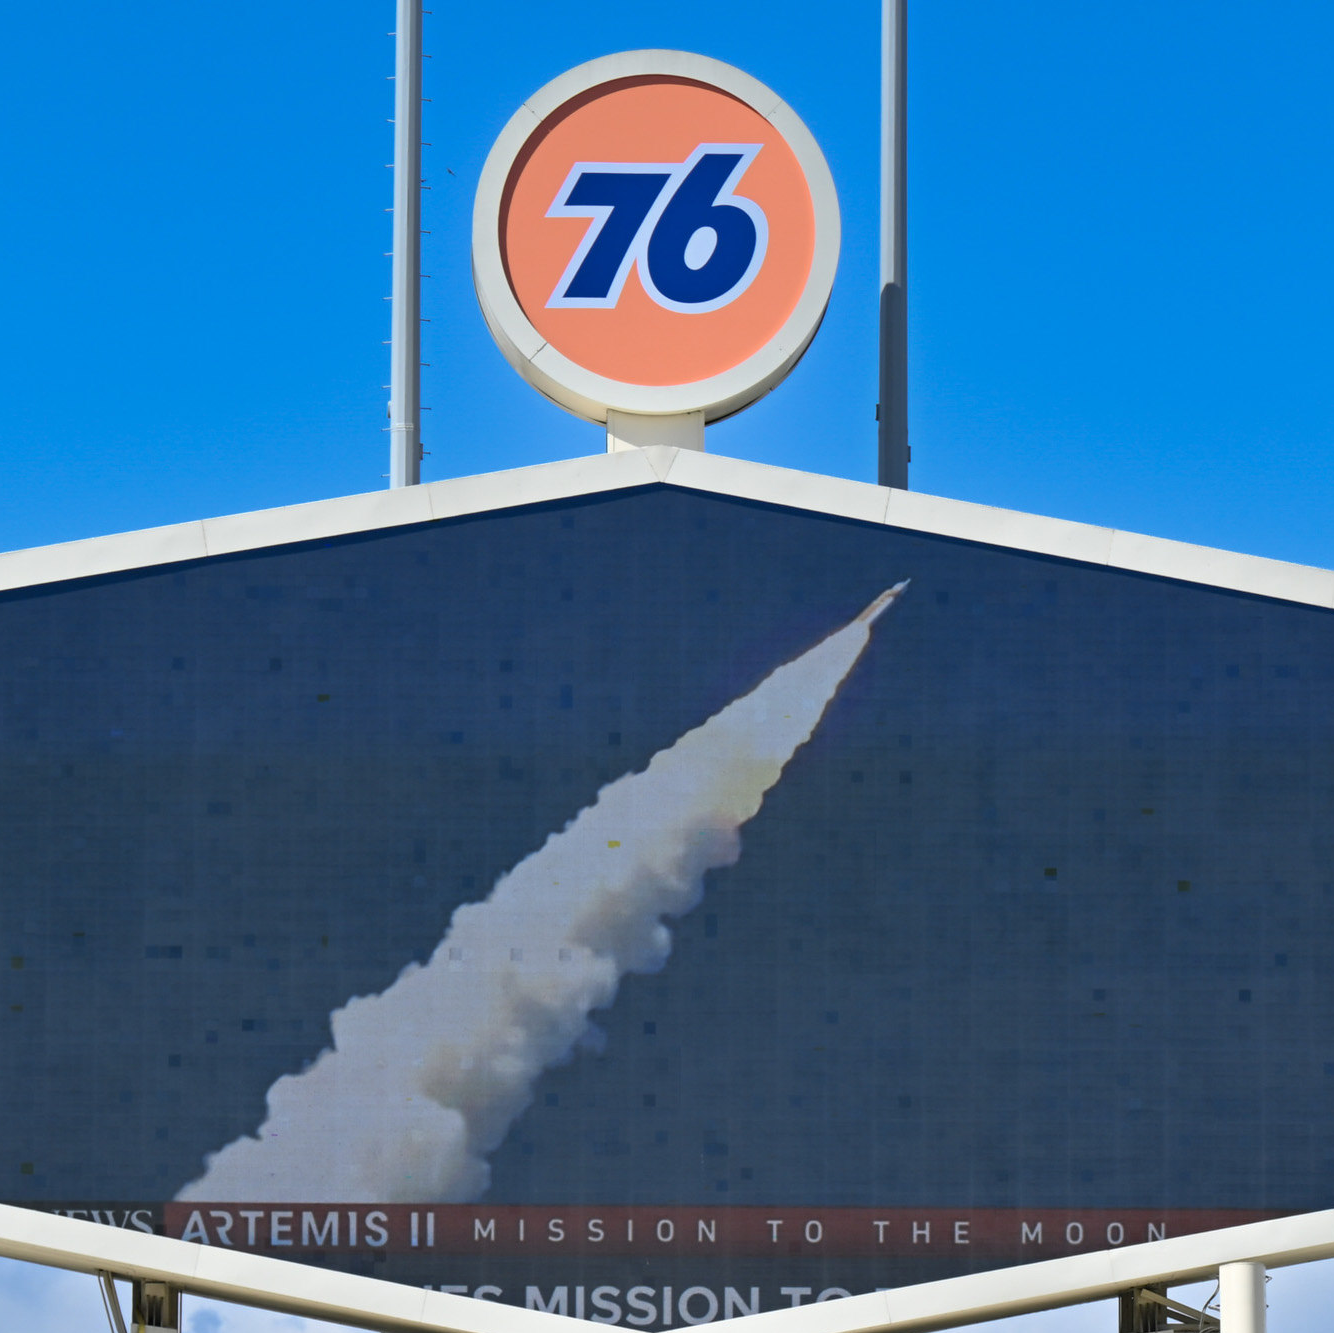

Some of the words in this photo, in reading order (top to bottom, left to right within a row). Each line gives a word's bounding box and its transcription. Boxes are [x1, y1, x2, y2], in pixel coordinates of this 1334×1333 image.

[545, 143, 768, 314] 76
[182, 1209, 389, 1247] ARTEMIS
[410, 1211, 435, 1248] II
[473, 1217, 717, 1243] MISSION
[767, 1220, 823, 1243] TO
[873, 1221, 970, 1245] THE
[1022, 1222, 1167, 1246] MOON
[526, 1286, 759, 1325] MISSION
